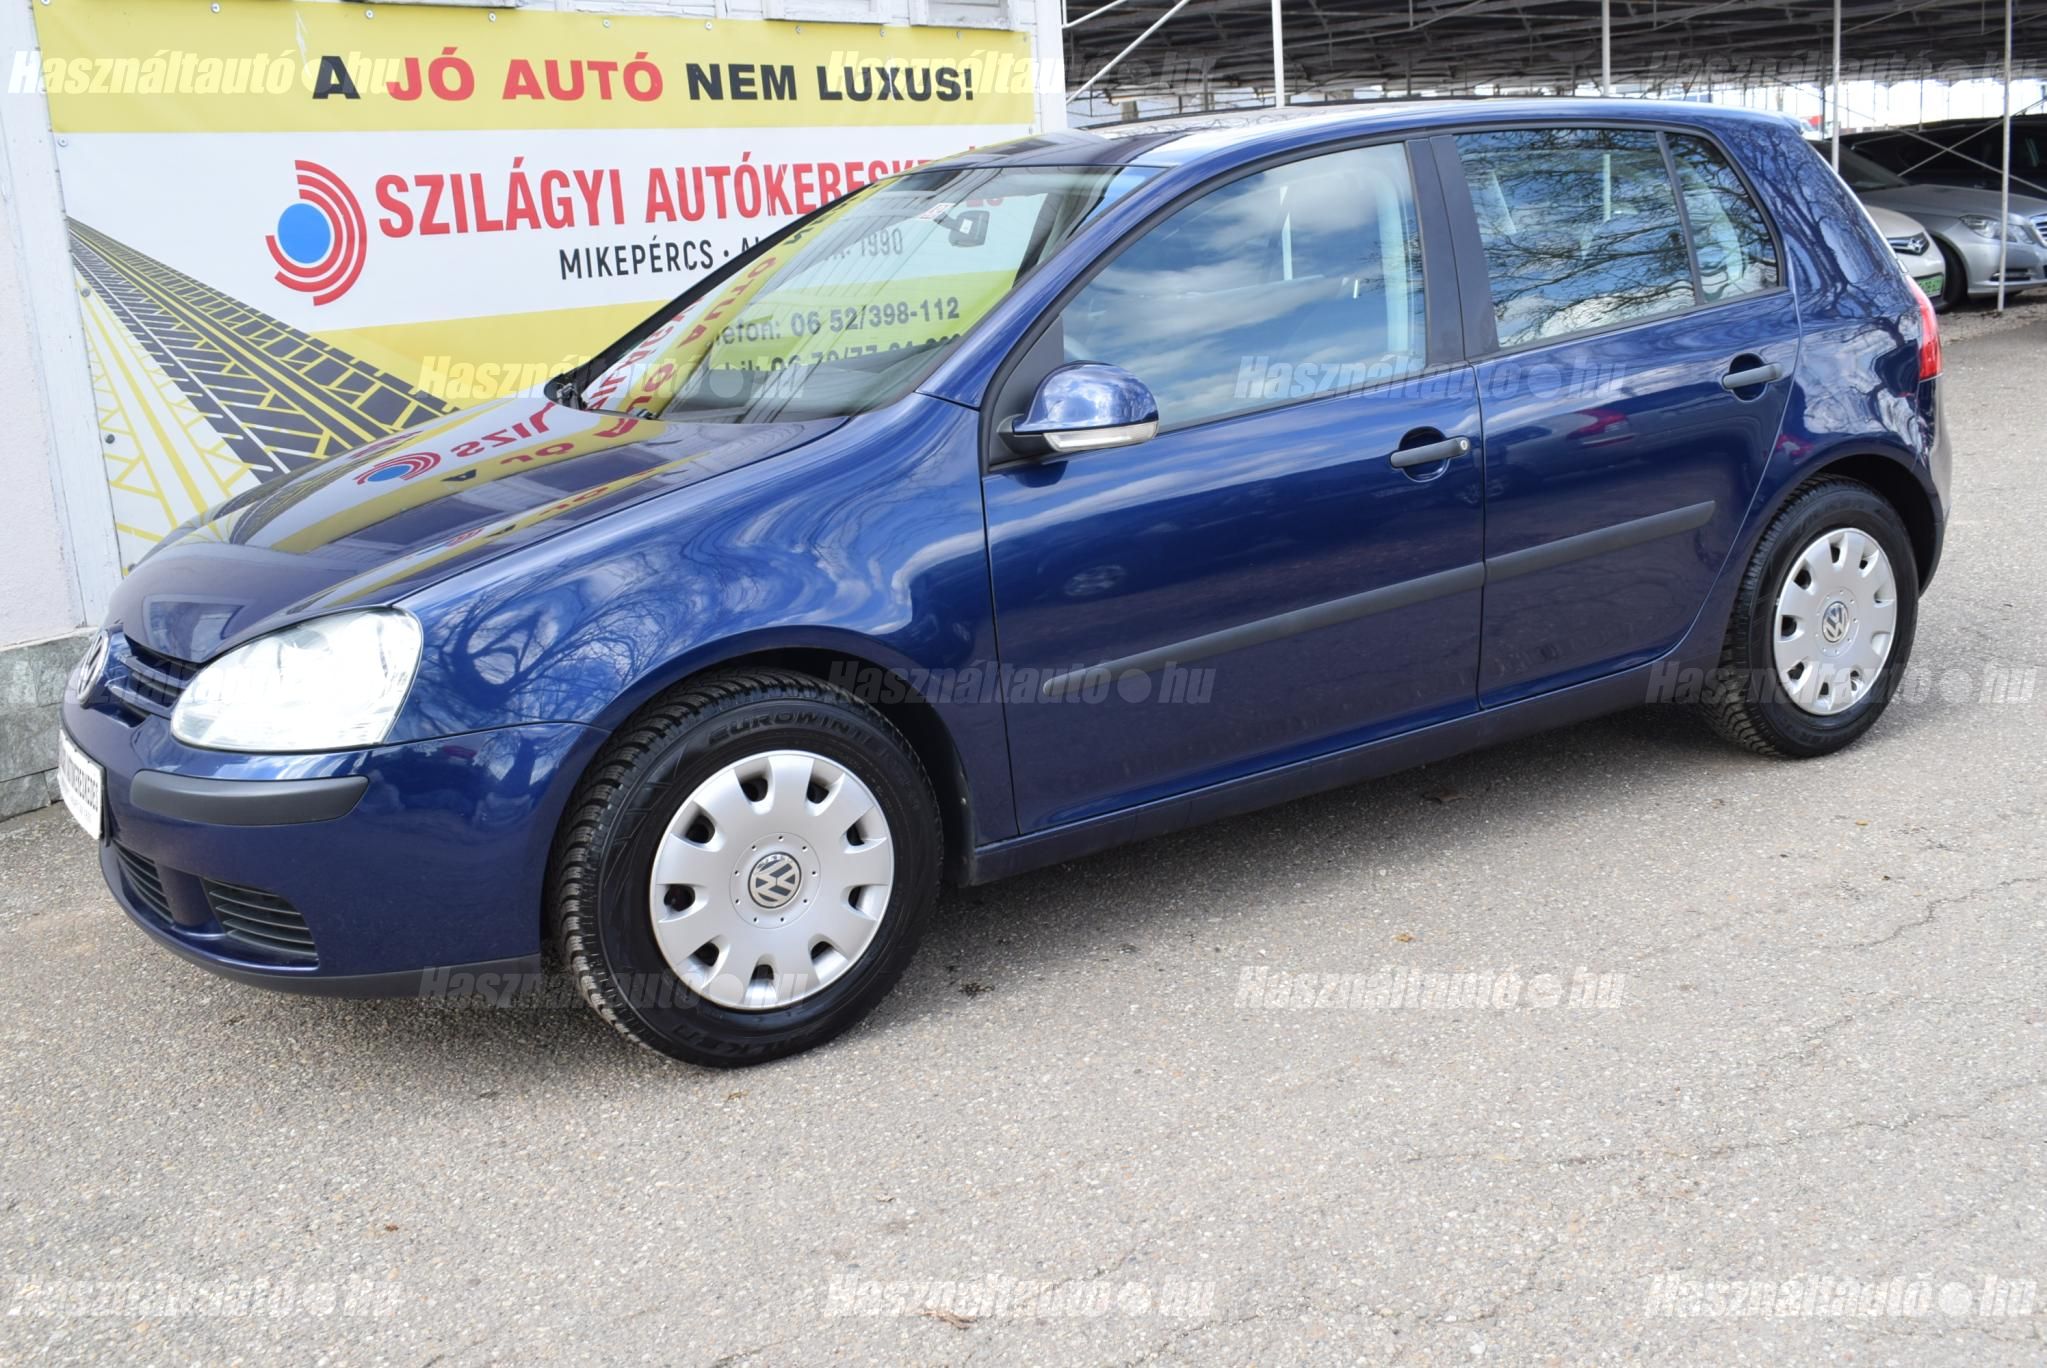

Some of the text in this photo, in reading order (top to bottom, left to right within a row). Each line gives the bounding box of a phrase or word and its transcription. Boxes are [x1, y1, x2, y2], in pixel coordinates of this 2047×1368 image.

[312, 47, 974, 101] A JÓ AUTÓ NEM LUXUS!
[375, 156, 625, 238] SZILÁGYI
[559, 235, 714, 280] MIKEPÉRCS
[860, 227, 903, 256] 1990
[790, 310, 822, 337] 06
[830, 296, 960, 333] 52/398-112
